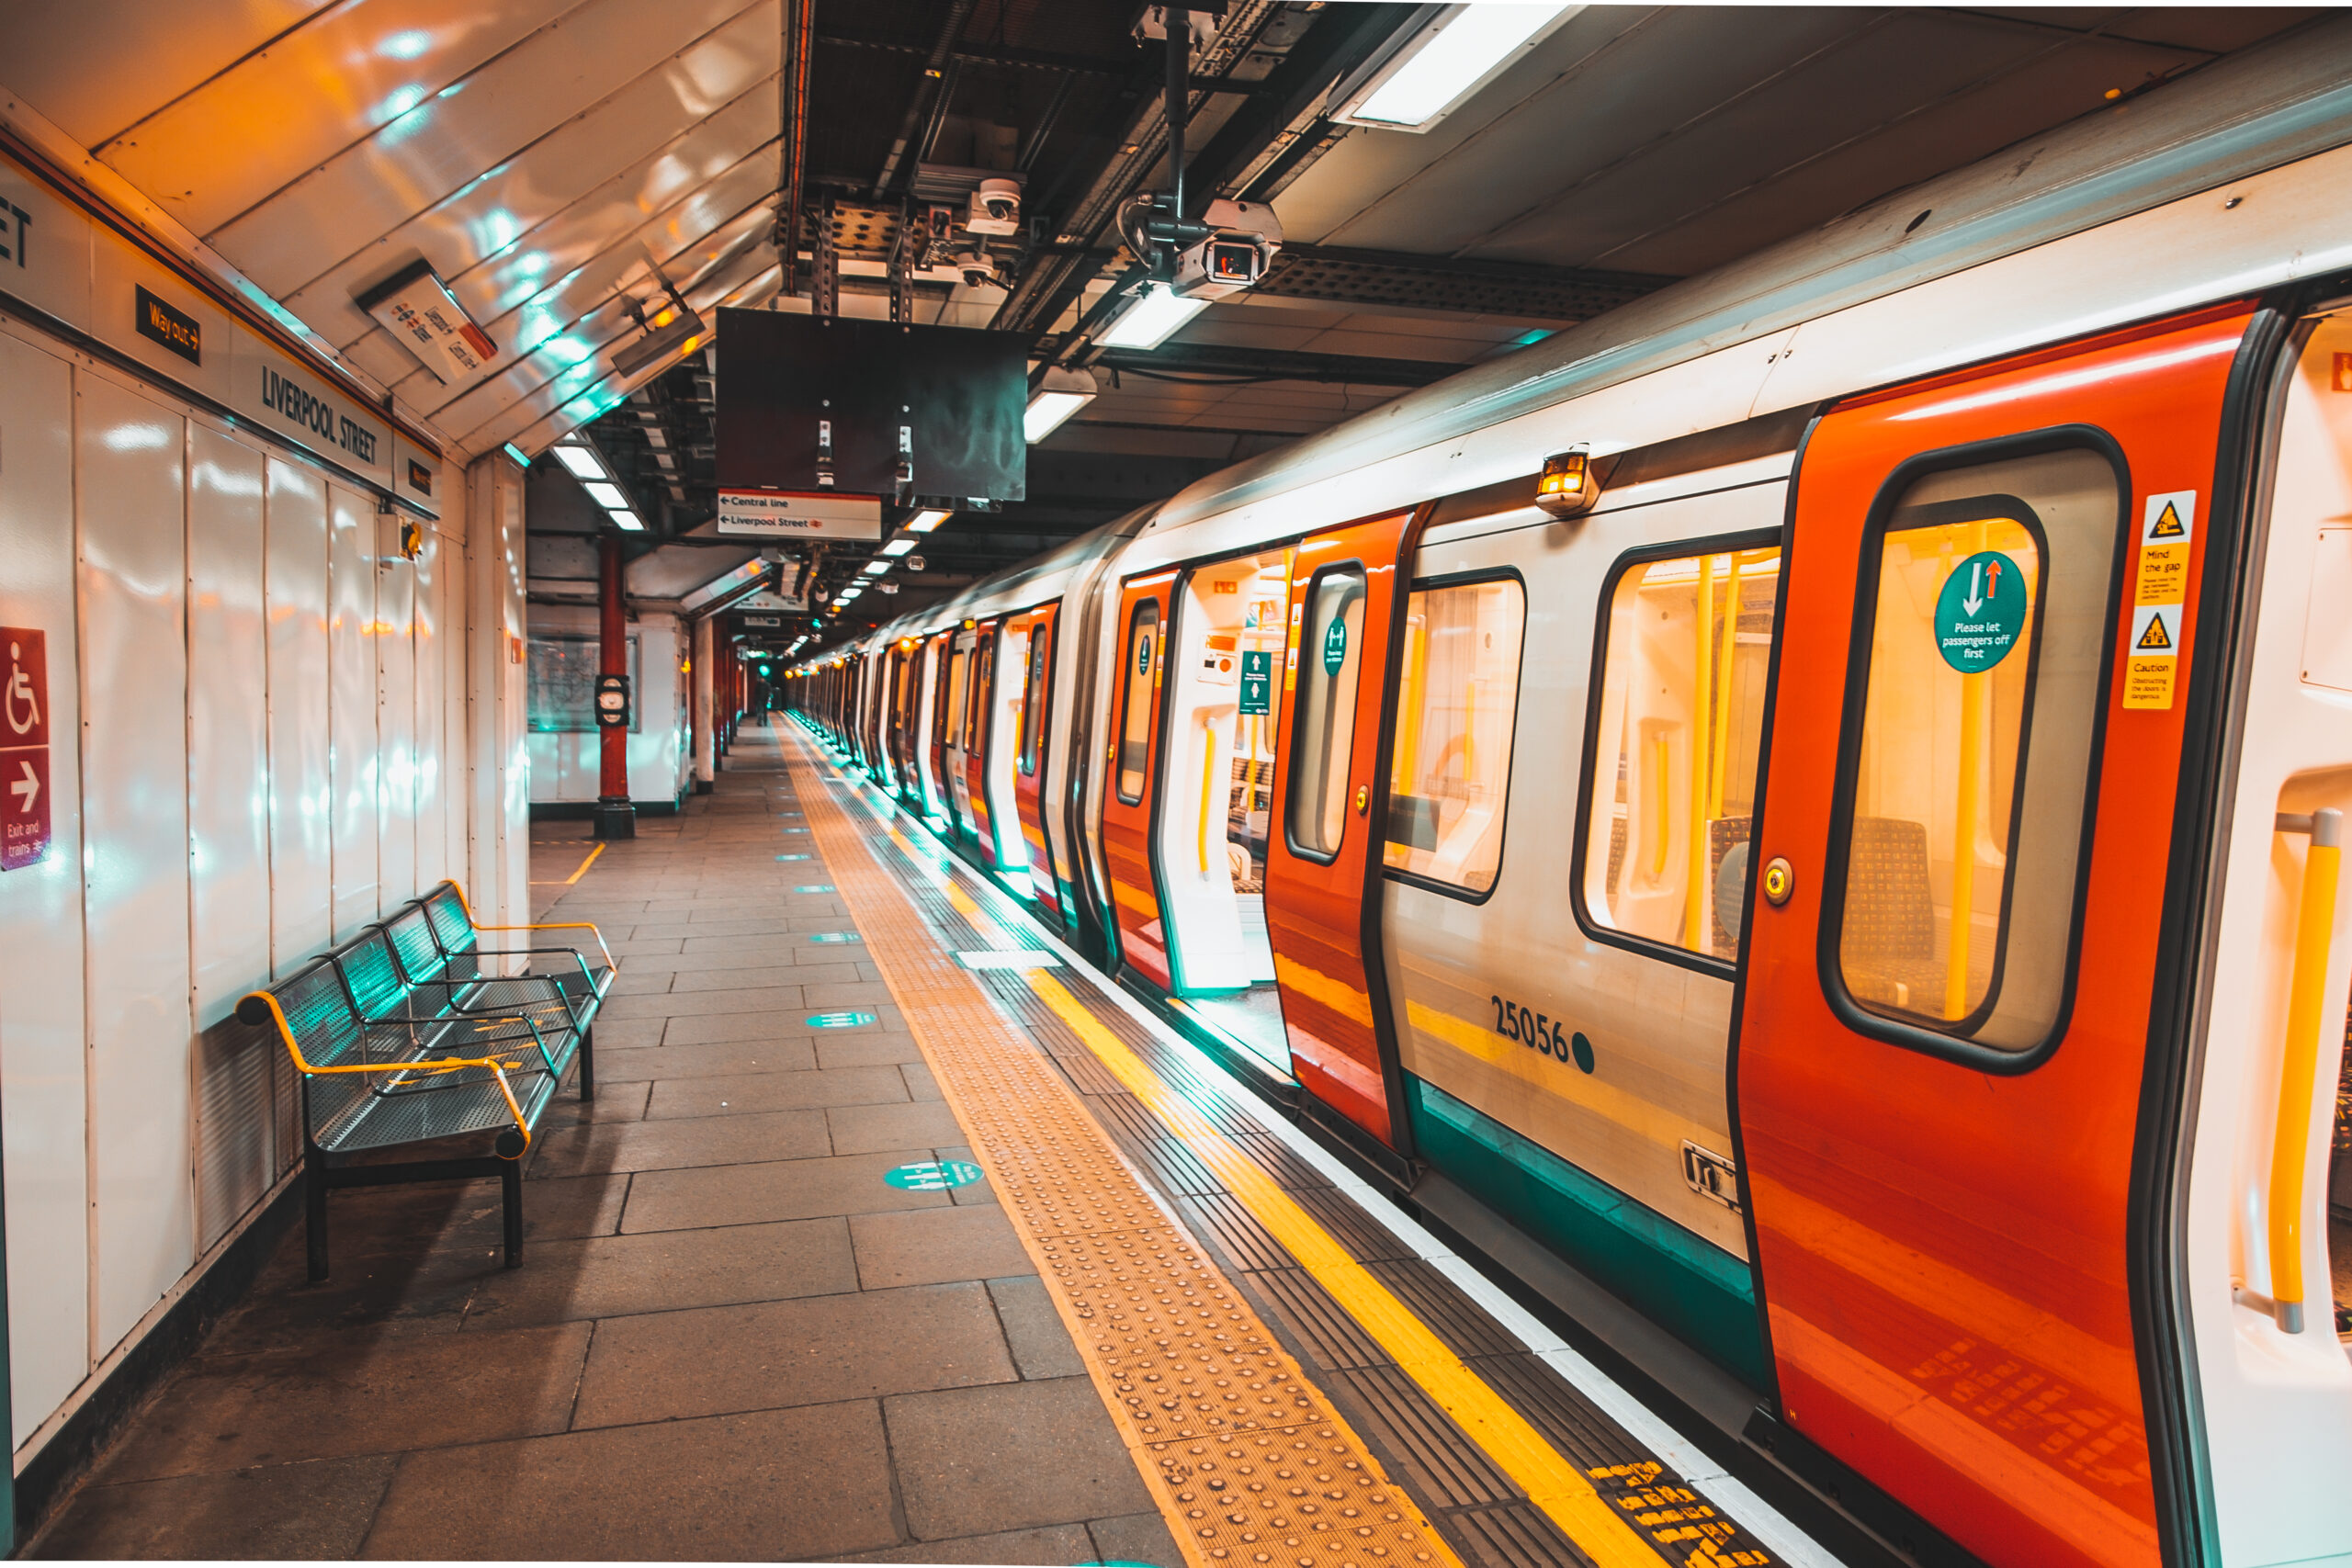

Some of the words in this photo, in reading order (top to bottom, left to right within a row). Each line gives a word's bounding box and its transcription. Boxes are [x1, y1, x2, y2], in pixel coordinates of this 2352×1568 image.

[149, 301, 171, 340] Way
[172, 321, 190, 346] out
[262, 365, 336, 444] LIVERPOOL
[339, 414, 377, 466] STREET
[730, 496, 767, 508] Central
[770, 498, 788, 508] line
[730, 515, 775, 526] Liverpool
[778, 517, 808, 528] Street
[2146, 549, 2170, 559] Mind
[2145, 564, 2161, 573] the
[2164, 563, 2181, 574] gap
[1954, 622, 1985, 633] Please
[1985, 621, 2002, 633] let
[1942, 637, 1994, 649] passengers
[1994, 634, 2011, 645] off
[1963, 648, 1985, 659] first
[2133, 662, 2169, 672] Caution
[7, 822, 24, 839] Exit
[25, 818, 40, 835] and
[8, 840, 30, 858] trains
[1490, 994, 1569, 1063] 25056
